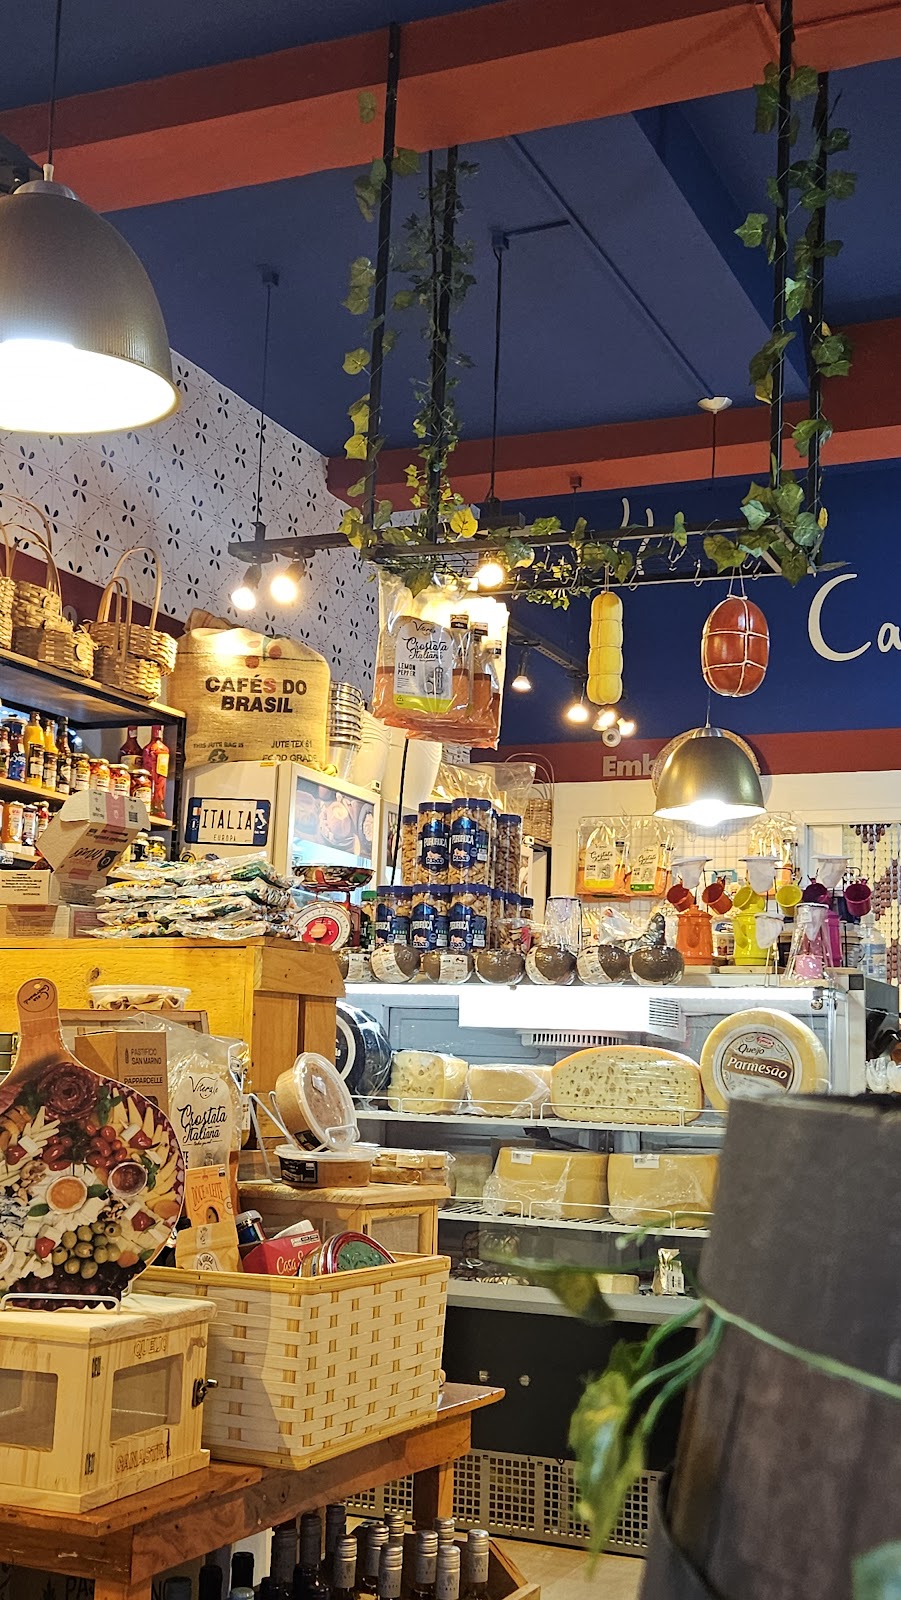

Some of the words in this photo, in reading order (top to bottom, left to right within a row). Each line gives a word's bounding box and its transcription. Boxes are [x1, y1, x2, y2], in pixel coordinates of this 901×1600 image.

[397, 662, 416, 670] LEMON
[397, 669, 416, 677] PEPPER
[205, 674, 277, 694] CAFÉS
[282, 679, 307, 695] DO
[220, 695, 293, 713] BRASIL
[271, 740, 290, 748] JUTE
[202, 809, 252, 830] ITALIA
[213, 834, 236, 842] EUROPA
[131, 1048, 157, 1057] PASTIFICIO
[737, 1043, 766, 1056] Queijo
[131, 1057, 143, 1065] SAN
[142, 1056, 162, 1065] MARINO
[727, 1056, 788, 1080] Parmesão
[124, 1076, 163, 1085] PAPPARDELLE
[276, 1256, 297, 1275] Casa
